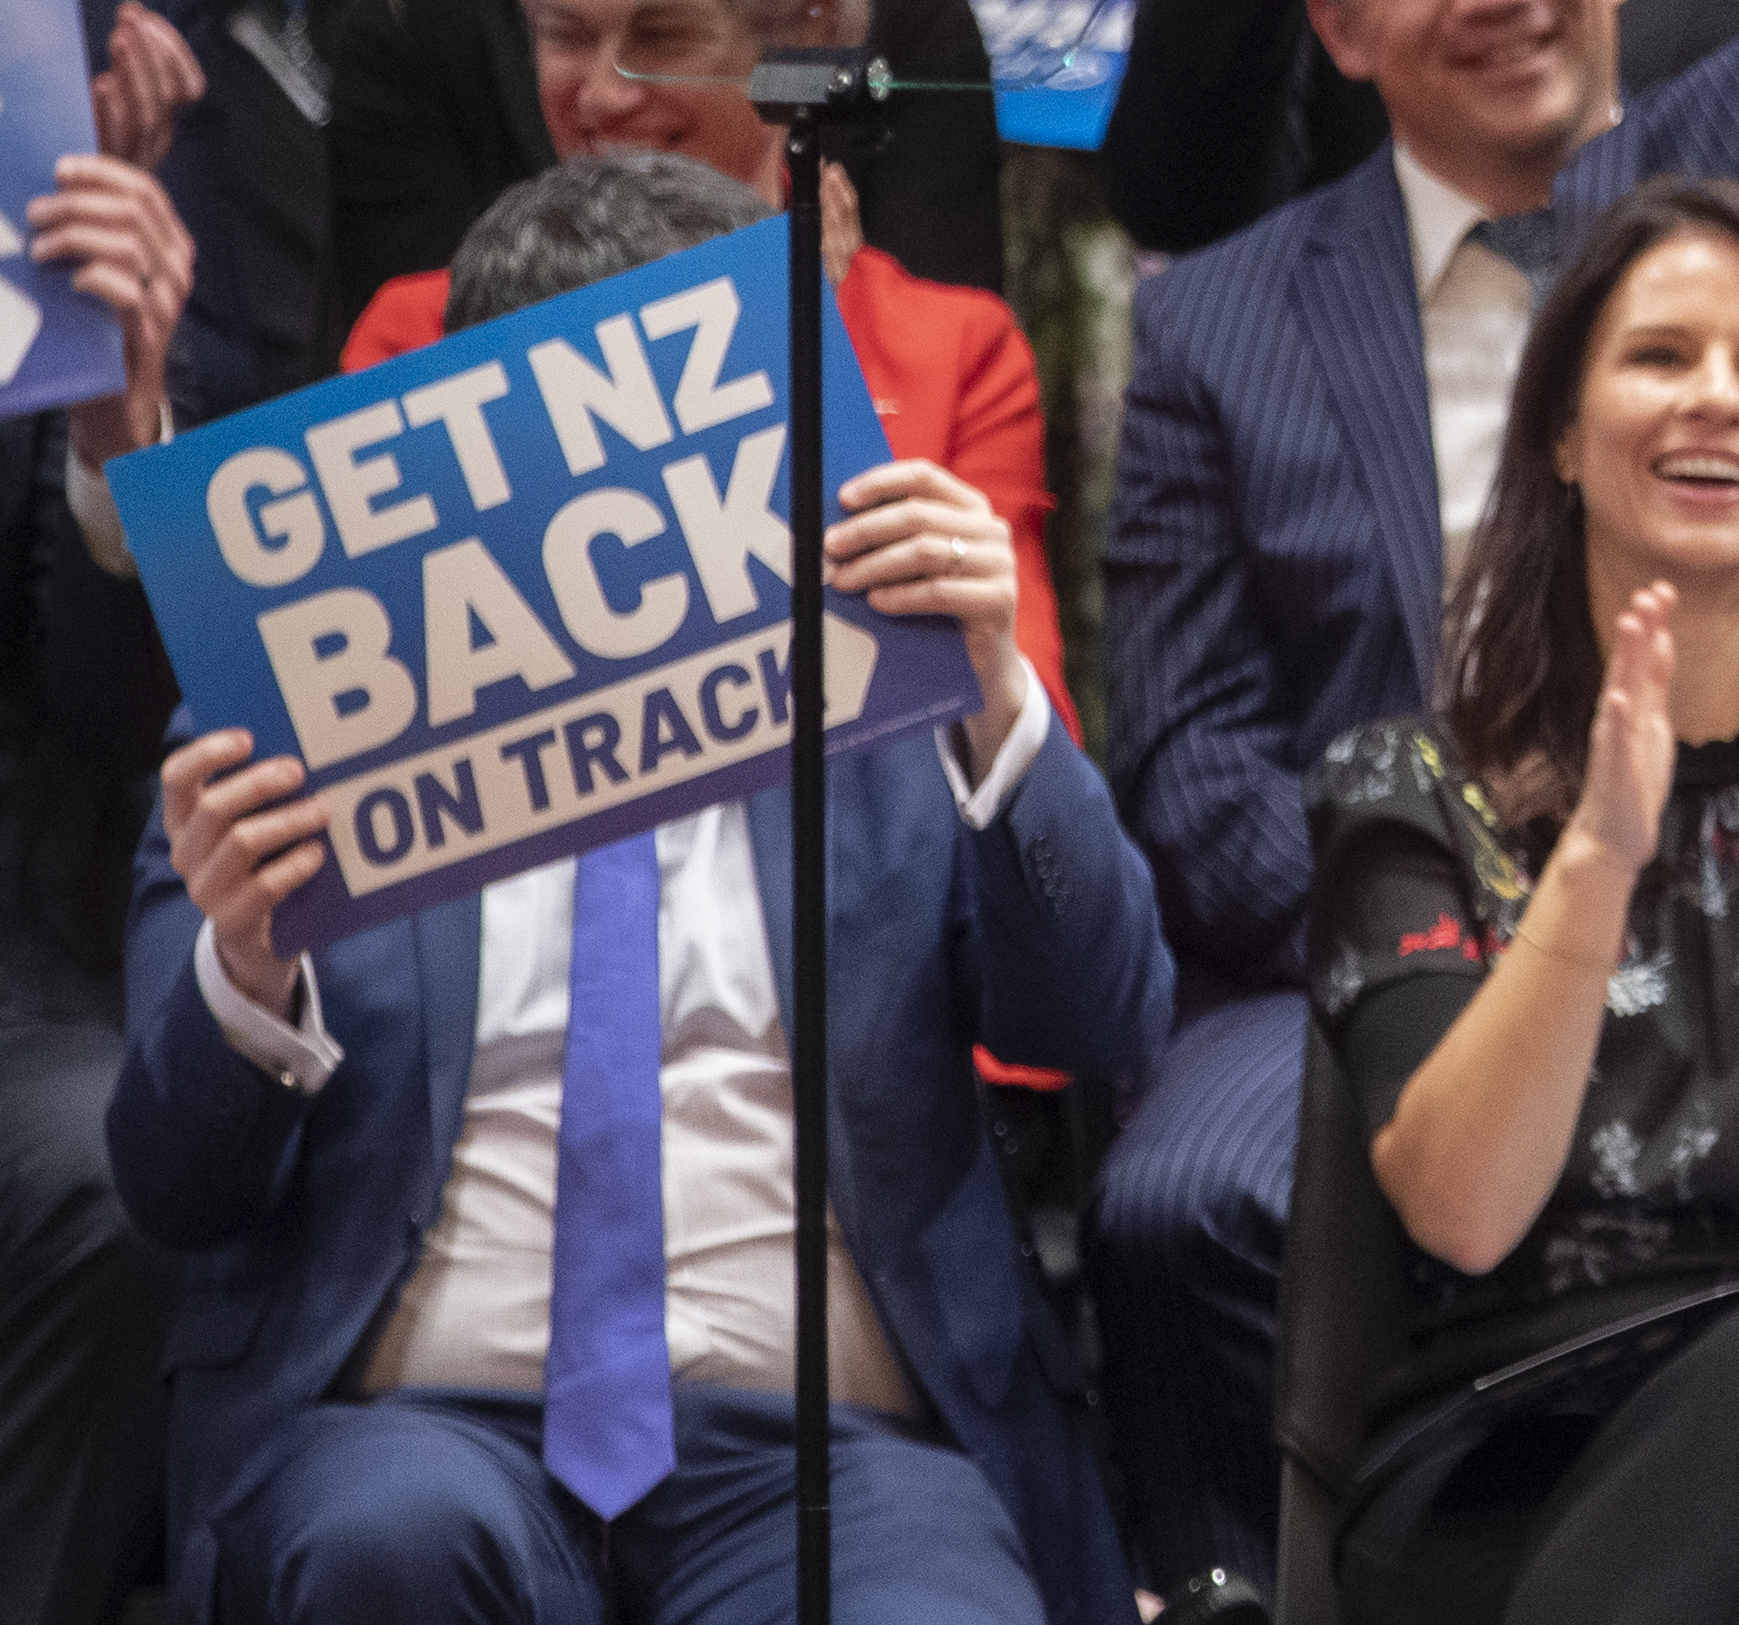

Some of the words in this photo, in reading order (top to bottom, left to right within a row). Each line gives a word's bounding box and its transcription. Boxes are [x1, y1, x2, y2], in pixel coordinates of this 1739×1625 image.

[205, 361, 513, 589] GET
[527, 277, 775, 477] NZ
[255, 422, 830, 773] BACK
[351, 775, 485, 868] ON
